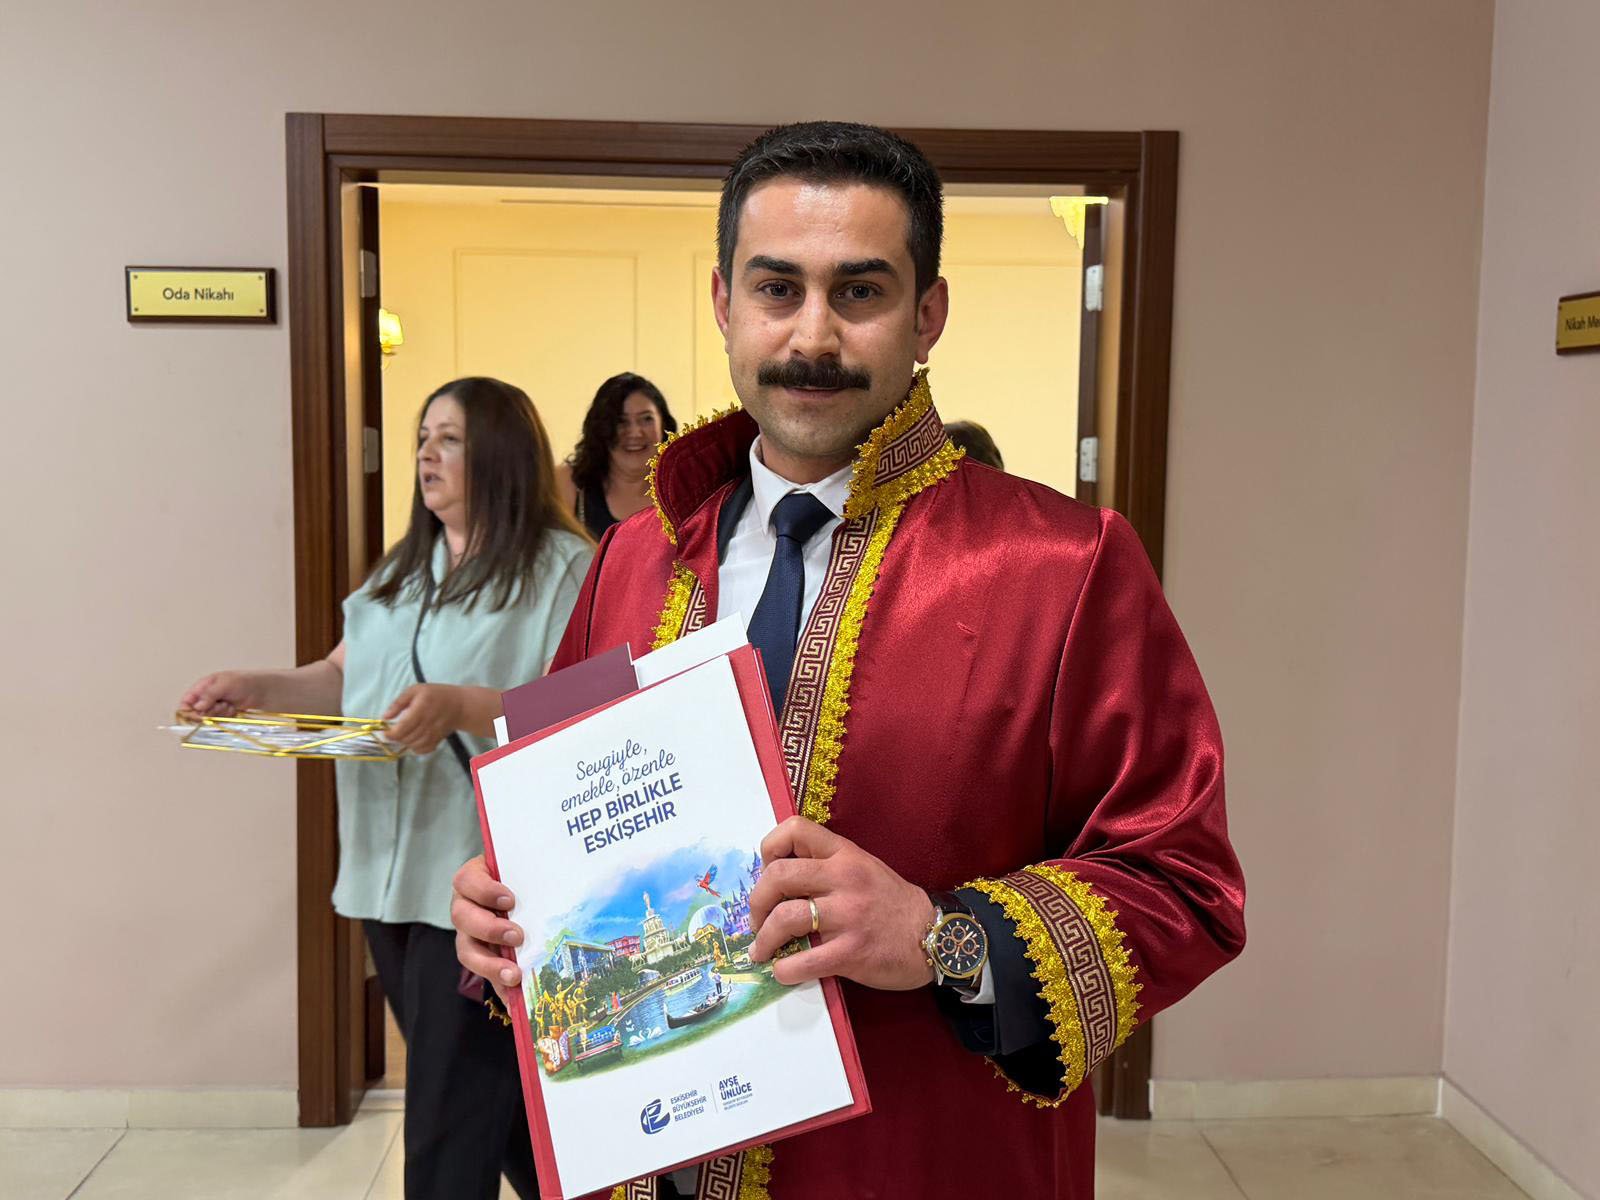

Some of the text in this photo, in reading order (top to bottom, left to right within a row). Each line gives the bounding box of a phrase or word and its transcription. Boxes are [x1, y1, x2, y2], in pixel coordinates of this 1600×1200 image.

[162, 287, 234, 301] Oda Nikahı
[1565, 315, 1586, 331] Nikah
[576, 738, 647, 781] Sevgiyle,
[561, 748, 676, 812] emekle, özenle
[566, 772, 683, 837] HEP BİRLİKLE
[583, 801, 677, 854] ESKİŞEHİR
[719, 1074, 738, 1091] AYŞE
[720, 1081, 752, 1101] ÜNLÜCE
